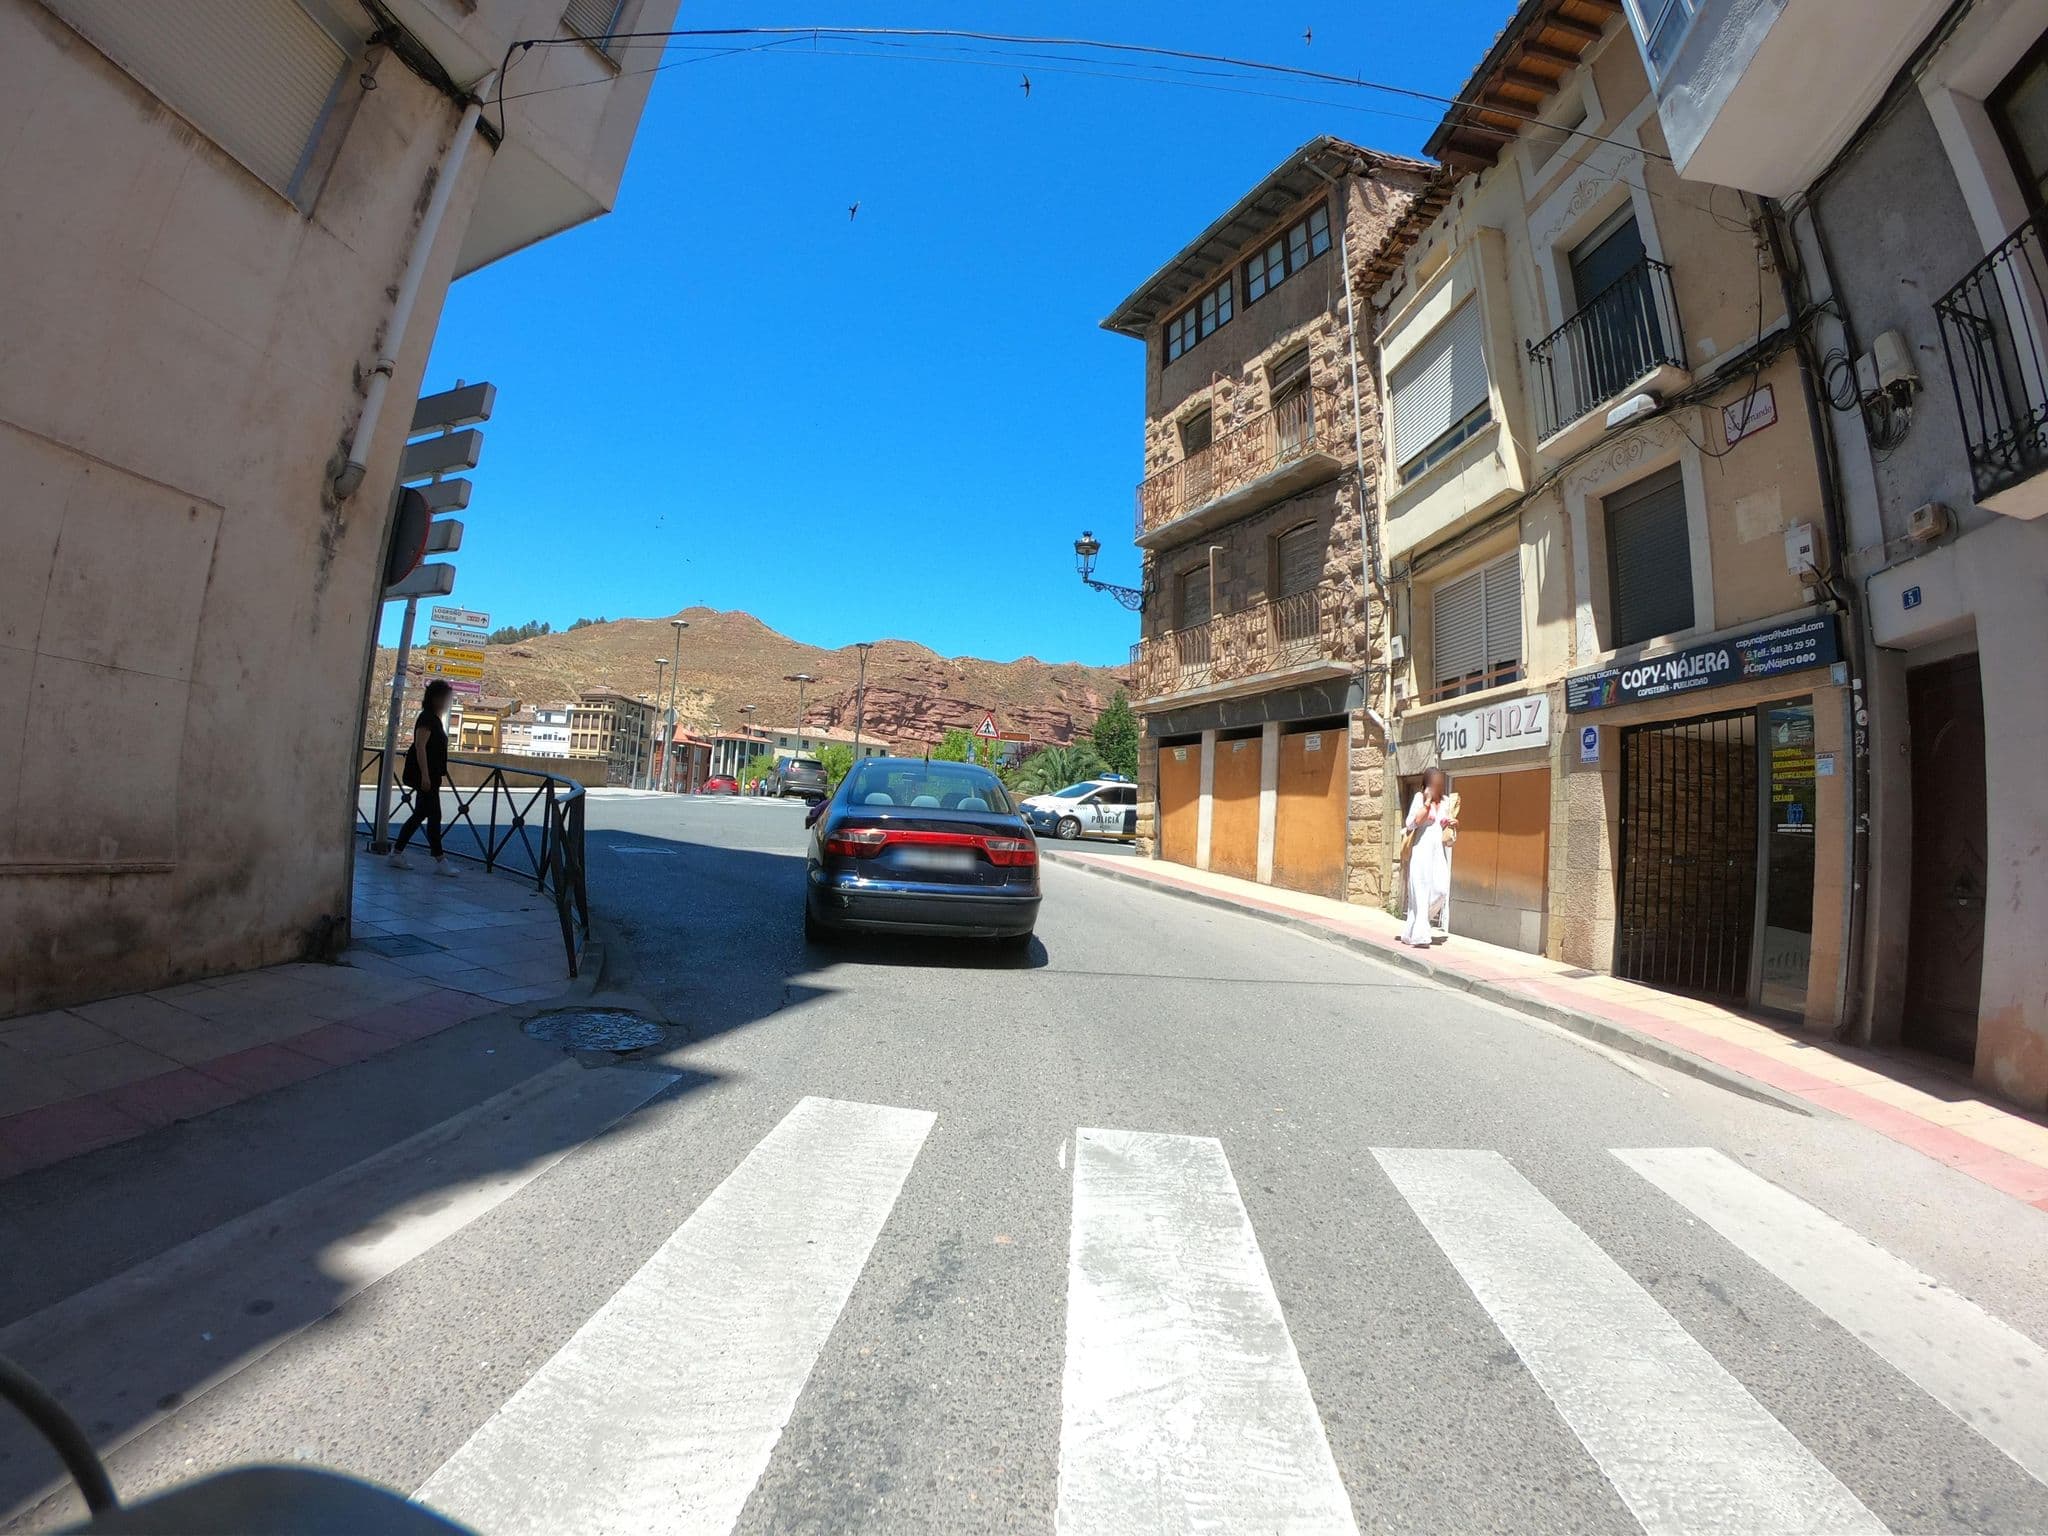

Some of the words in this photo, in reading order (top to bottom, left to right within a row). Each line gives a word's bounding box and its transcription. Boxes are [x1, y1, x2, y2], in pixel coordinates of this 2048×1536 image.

[1783, 643, 1793, 653] 36
[1794, 641, 1804, 650] 29
[1805, 638, 1816, 648] 50
[1596, 668, 1621, 679] DIGITAL
[1621, 649, 1730, 690] COPY-NÁJERA
